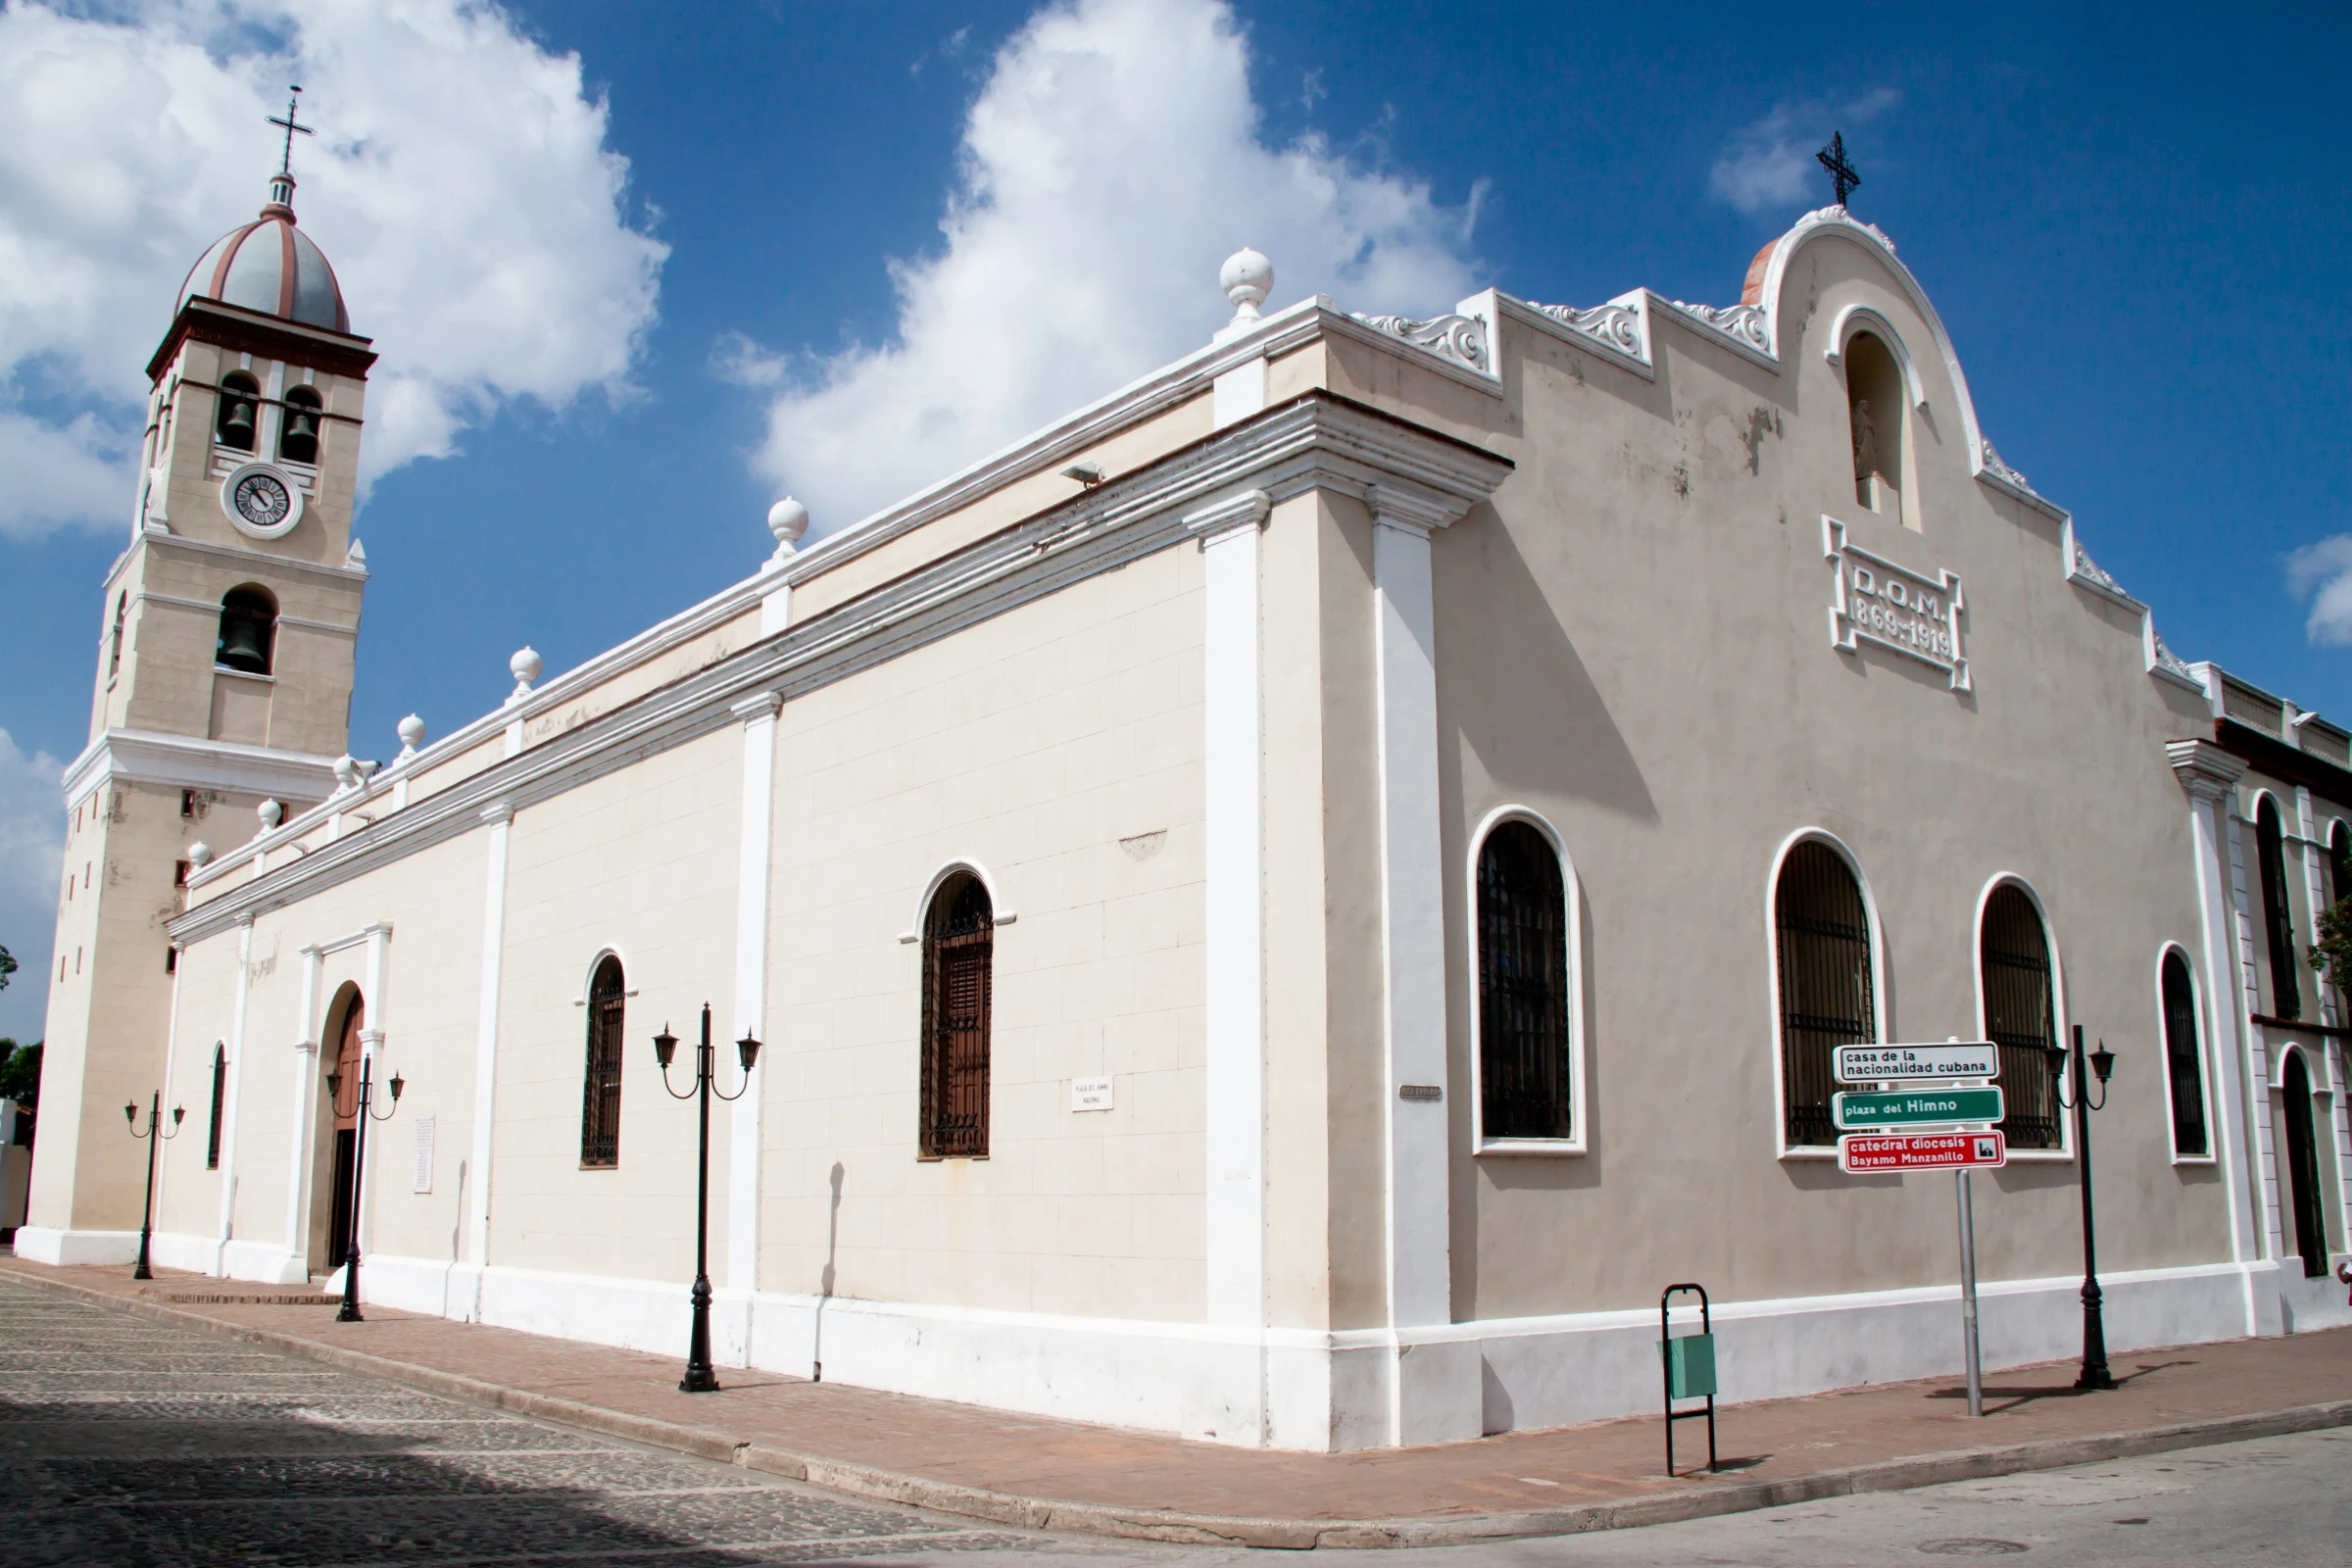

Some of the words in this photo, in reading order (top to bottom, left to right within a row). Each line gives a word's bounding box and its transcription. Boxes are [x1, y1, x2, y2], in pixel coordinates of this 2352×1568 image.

[1846, 1052, 1878, 1062] casa
[1881, 1051, 1897, 1062] de
[1903, 1050, 1916, 1061] la
[1846, 1062, 1934, 1075] nacionalidad
[1937, 1061, 1986, 1072] cubana
[1844, 1103, 1877, 1118] plaza
[1883, 1102, 1902, 1113] del
[1907, 1100, 1958, 1113] Himno
[1850, 1138, 1908, 1152] catedral
[1911, 1136, 1966, 1150] diocesis
[1850, 1154, 1897, 1167] Bayamo
[1901, 1152, 1964, 1164] Manzanillo
